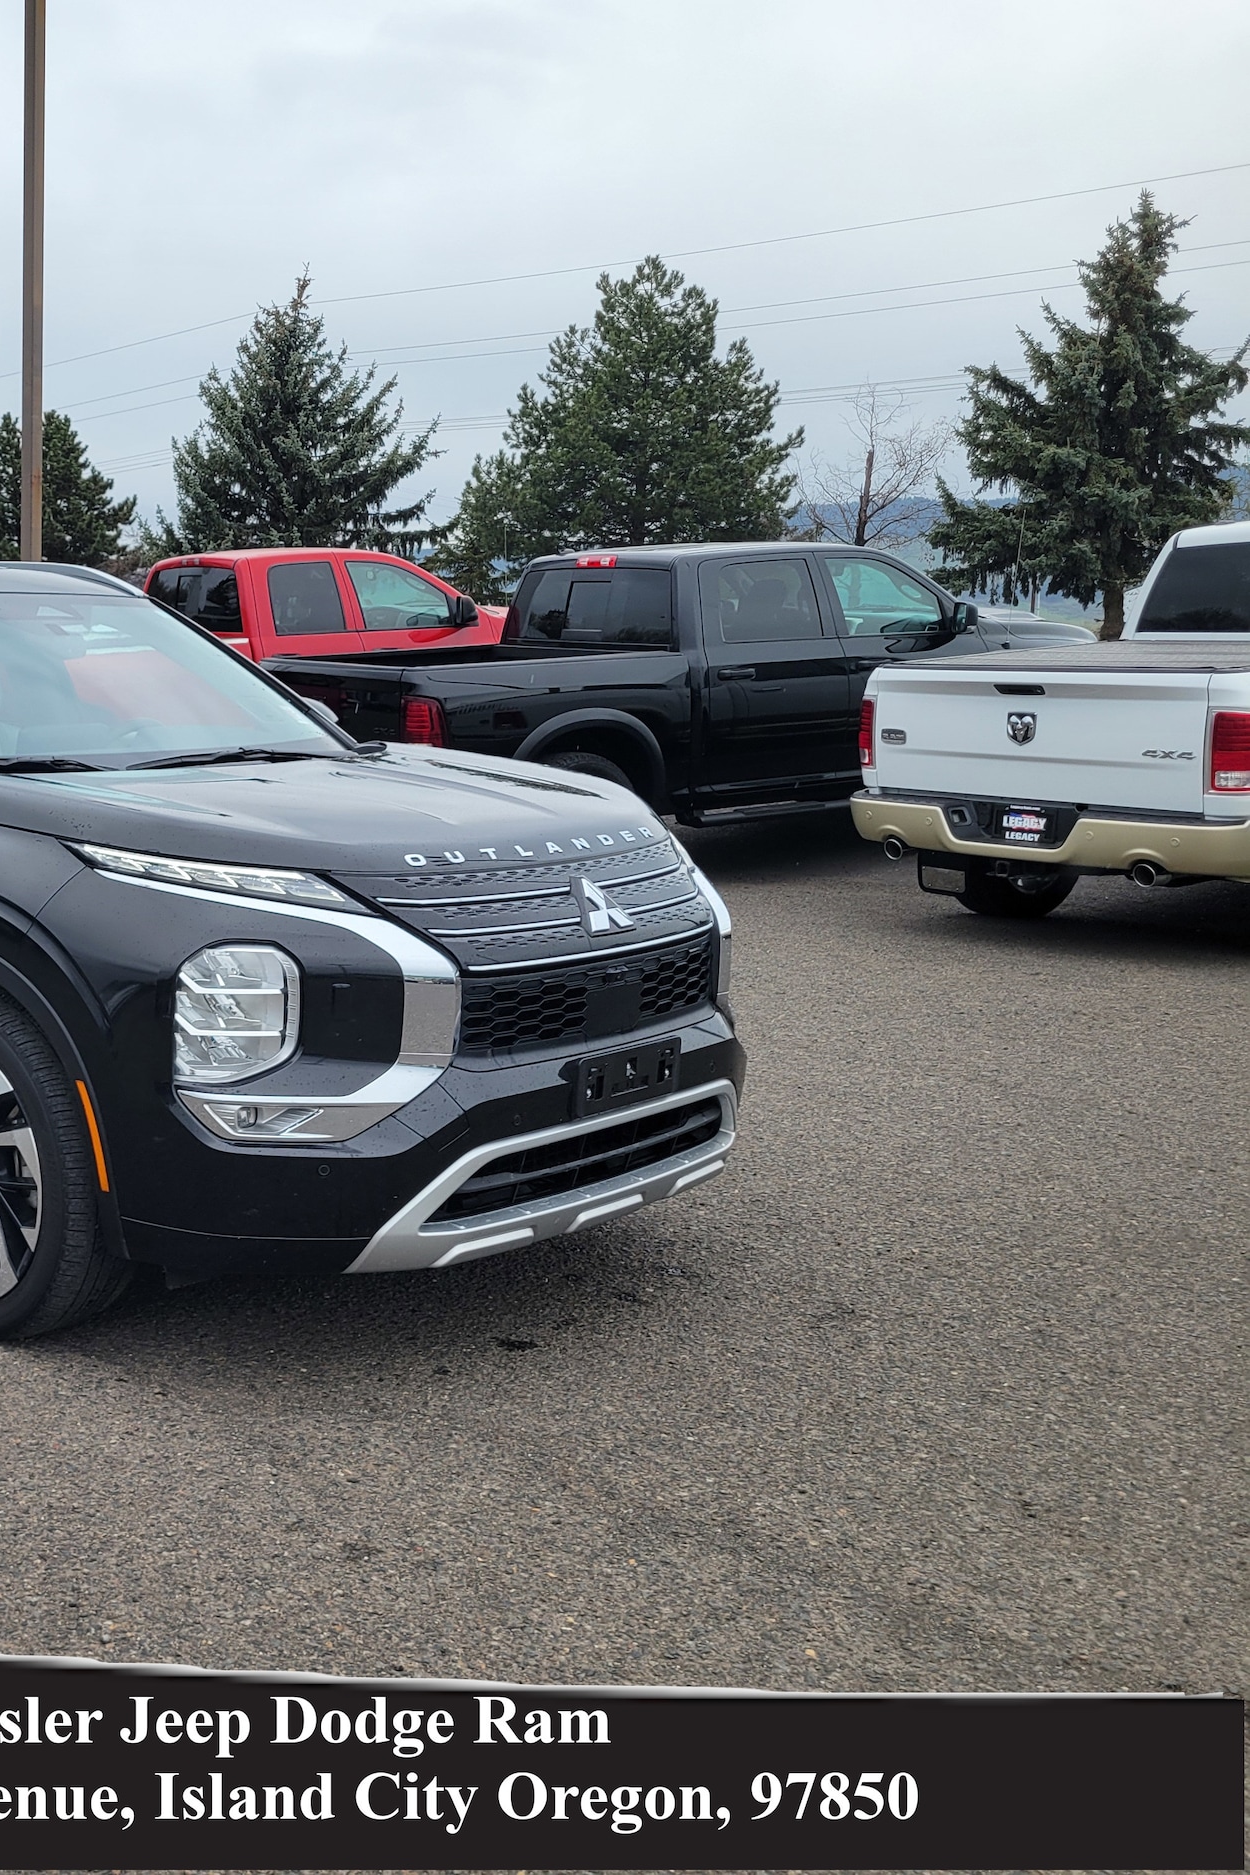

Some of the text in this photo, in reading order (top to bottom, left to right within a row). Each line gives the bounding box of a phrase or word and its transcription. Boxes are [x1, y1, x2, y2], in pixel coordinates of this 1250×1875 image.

[1002, 815, 1047, 831] LEGACY
[1005, 831, 1041, 842] LEGACY
[403, 826, 655, 868] OUTLANDER
